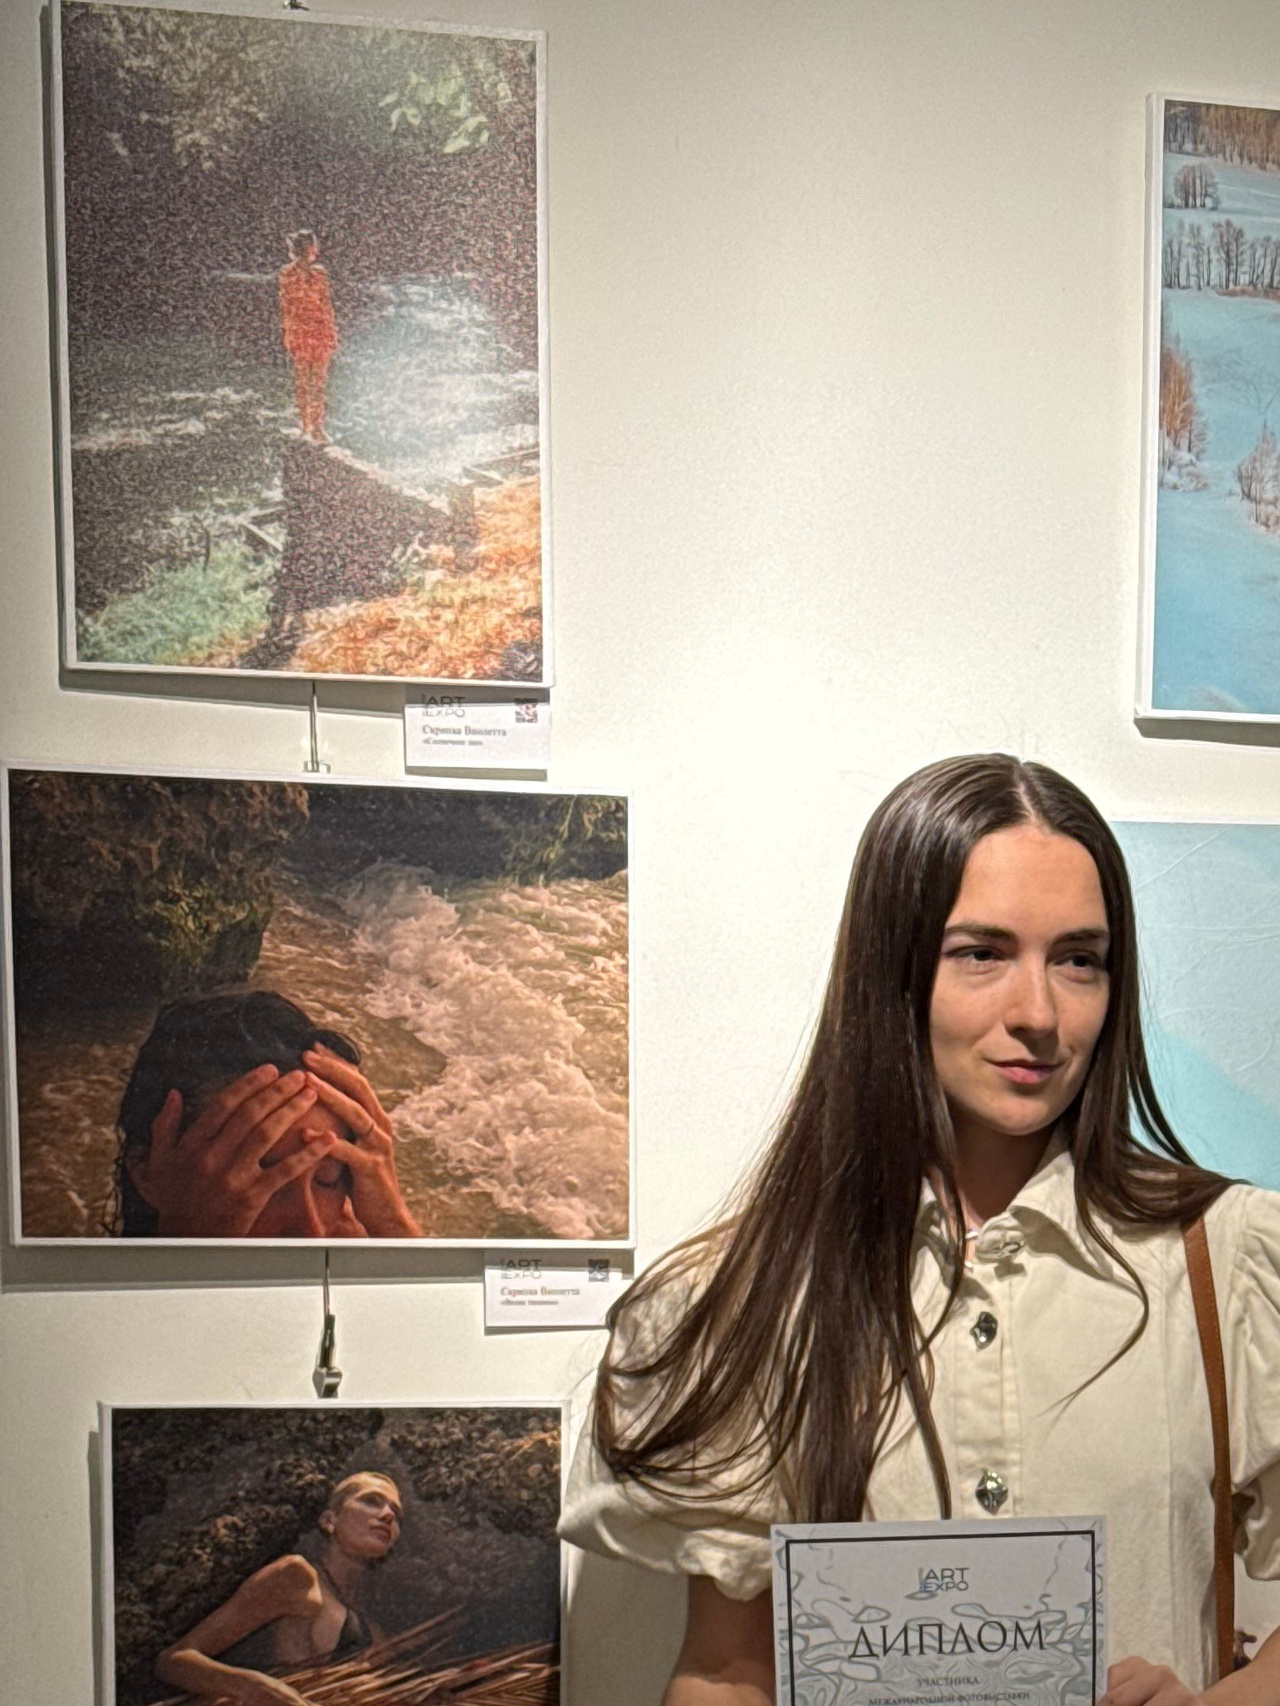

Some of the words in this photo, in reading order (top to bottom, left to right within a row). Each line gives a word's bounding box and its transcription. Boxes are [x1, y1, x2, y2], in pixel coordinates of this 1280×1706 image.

[924, 1568, 969, 1582] ART
[922, 1581, 969, 1593] EXPO
[848, 1619, 1047, 1660] ДИПЛОМ
[916, 1676, 980, 1688] УЧАСТНИКА
